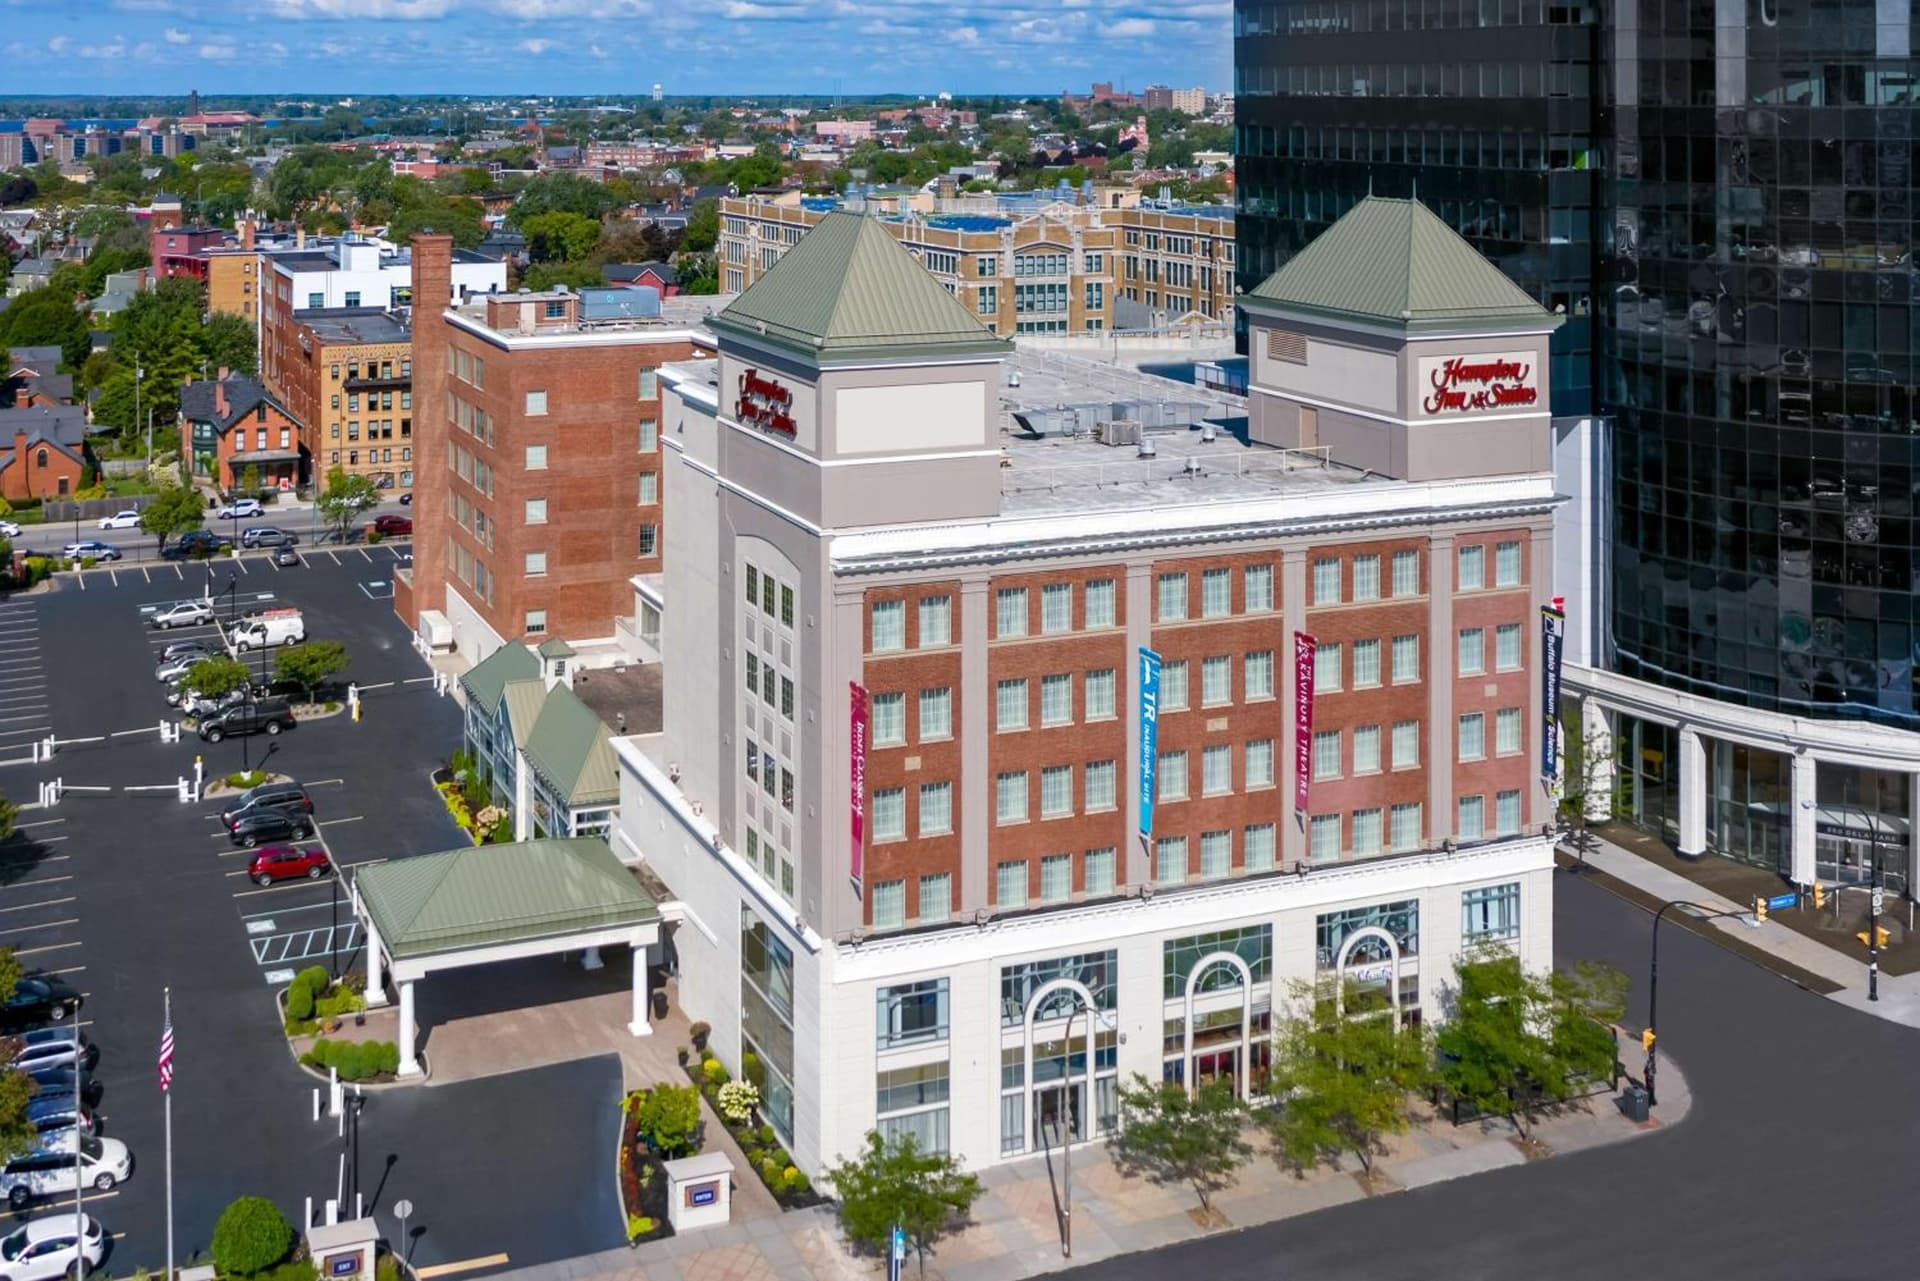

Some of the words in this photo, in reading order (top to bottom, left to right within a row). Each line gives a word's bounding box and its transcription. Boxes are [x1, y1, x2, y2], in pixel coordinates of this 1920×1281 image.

[1431, 357, 1529, 388] Hampton
[1423, 387, 1472, 414] Inn
[1470, 391, 1488, 410] &
[1484, 383, 1537, 408] Suites
[1547, 634, 1555, 670] Buffalo
[1547, 672, 1555, 713] Museum
[1547, 725, 1555, 764] Science
[1299, 739, 1308, 797] THEATRE
